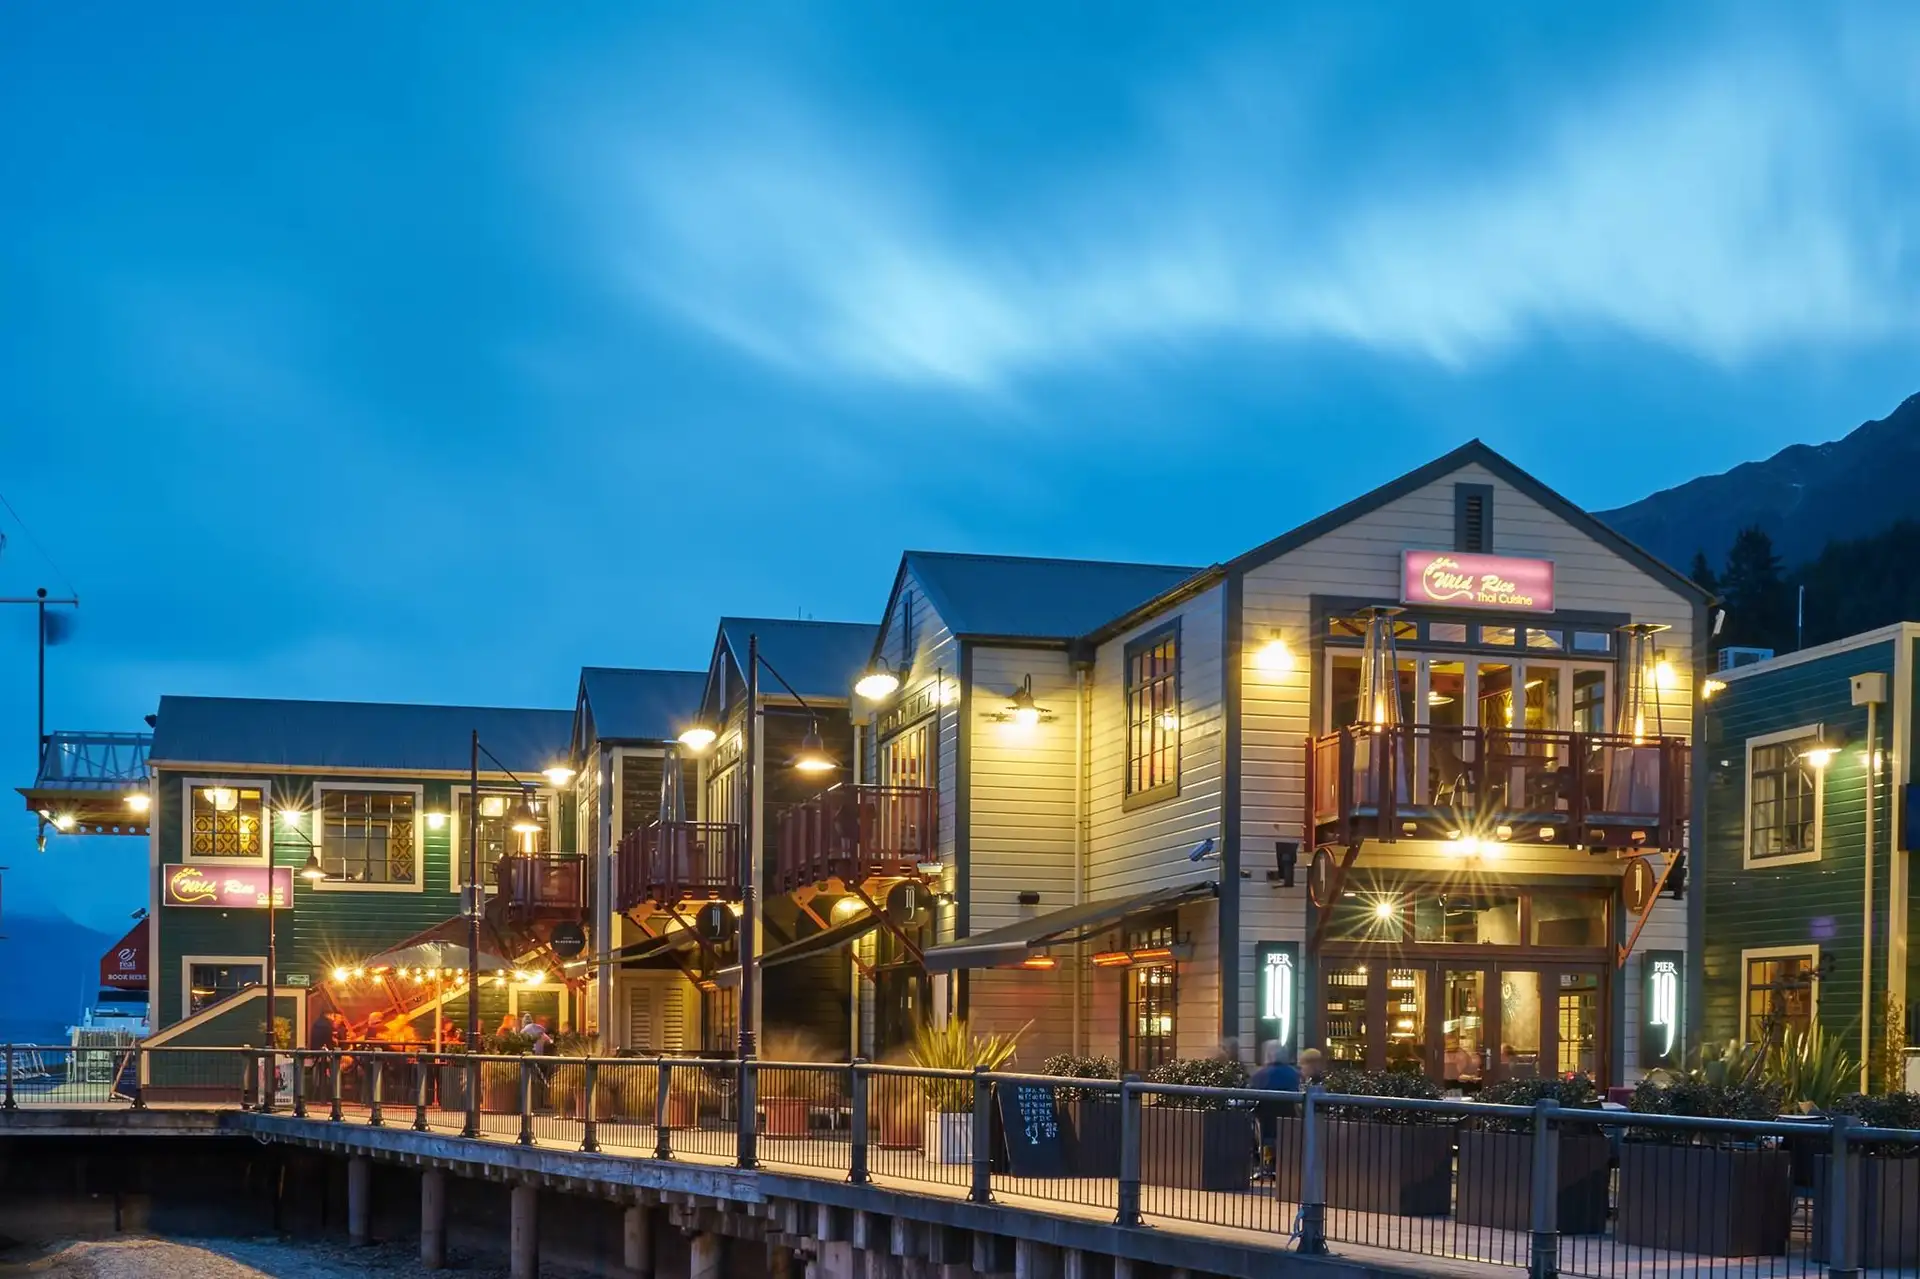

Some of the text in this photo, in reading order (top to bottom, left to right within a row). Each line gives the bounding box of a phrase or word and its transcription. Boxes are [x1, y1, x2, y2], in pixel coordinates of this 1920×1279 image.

[1432, 571, 1516, 593] Wild Rice
[1477, 592, 1533, 606] Thai Cuisine
[179, 878, 256, 894] Wild Rice
[1267, 953, 1293, 968] PIER
[1654, 961, 1678, 975] PIER
[1262, 964, 1291, 1047] 19
[1650, 972, 1676, 1058] 19
